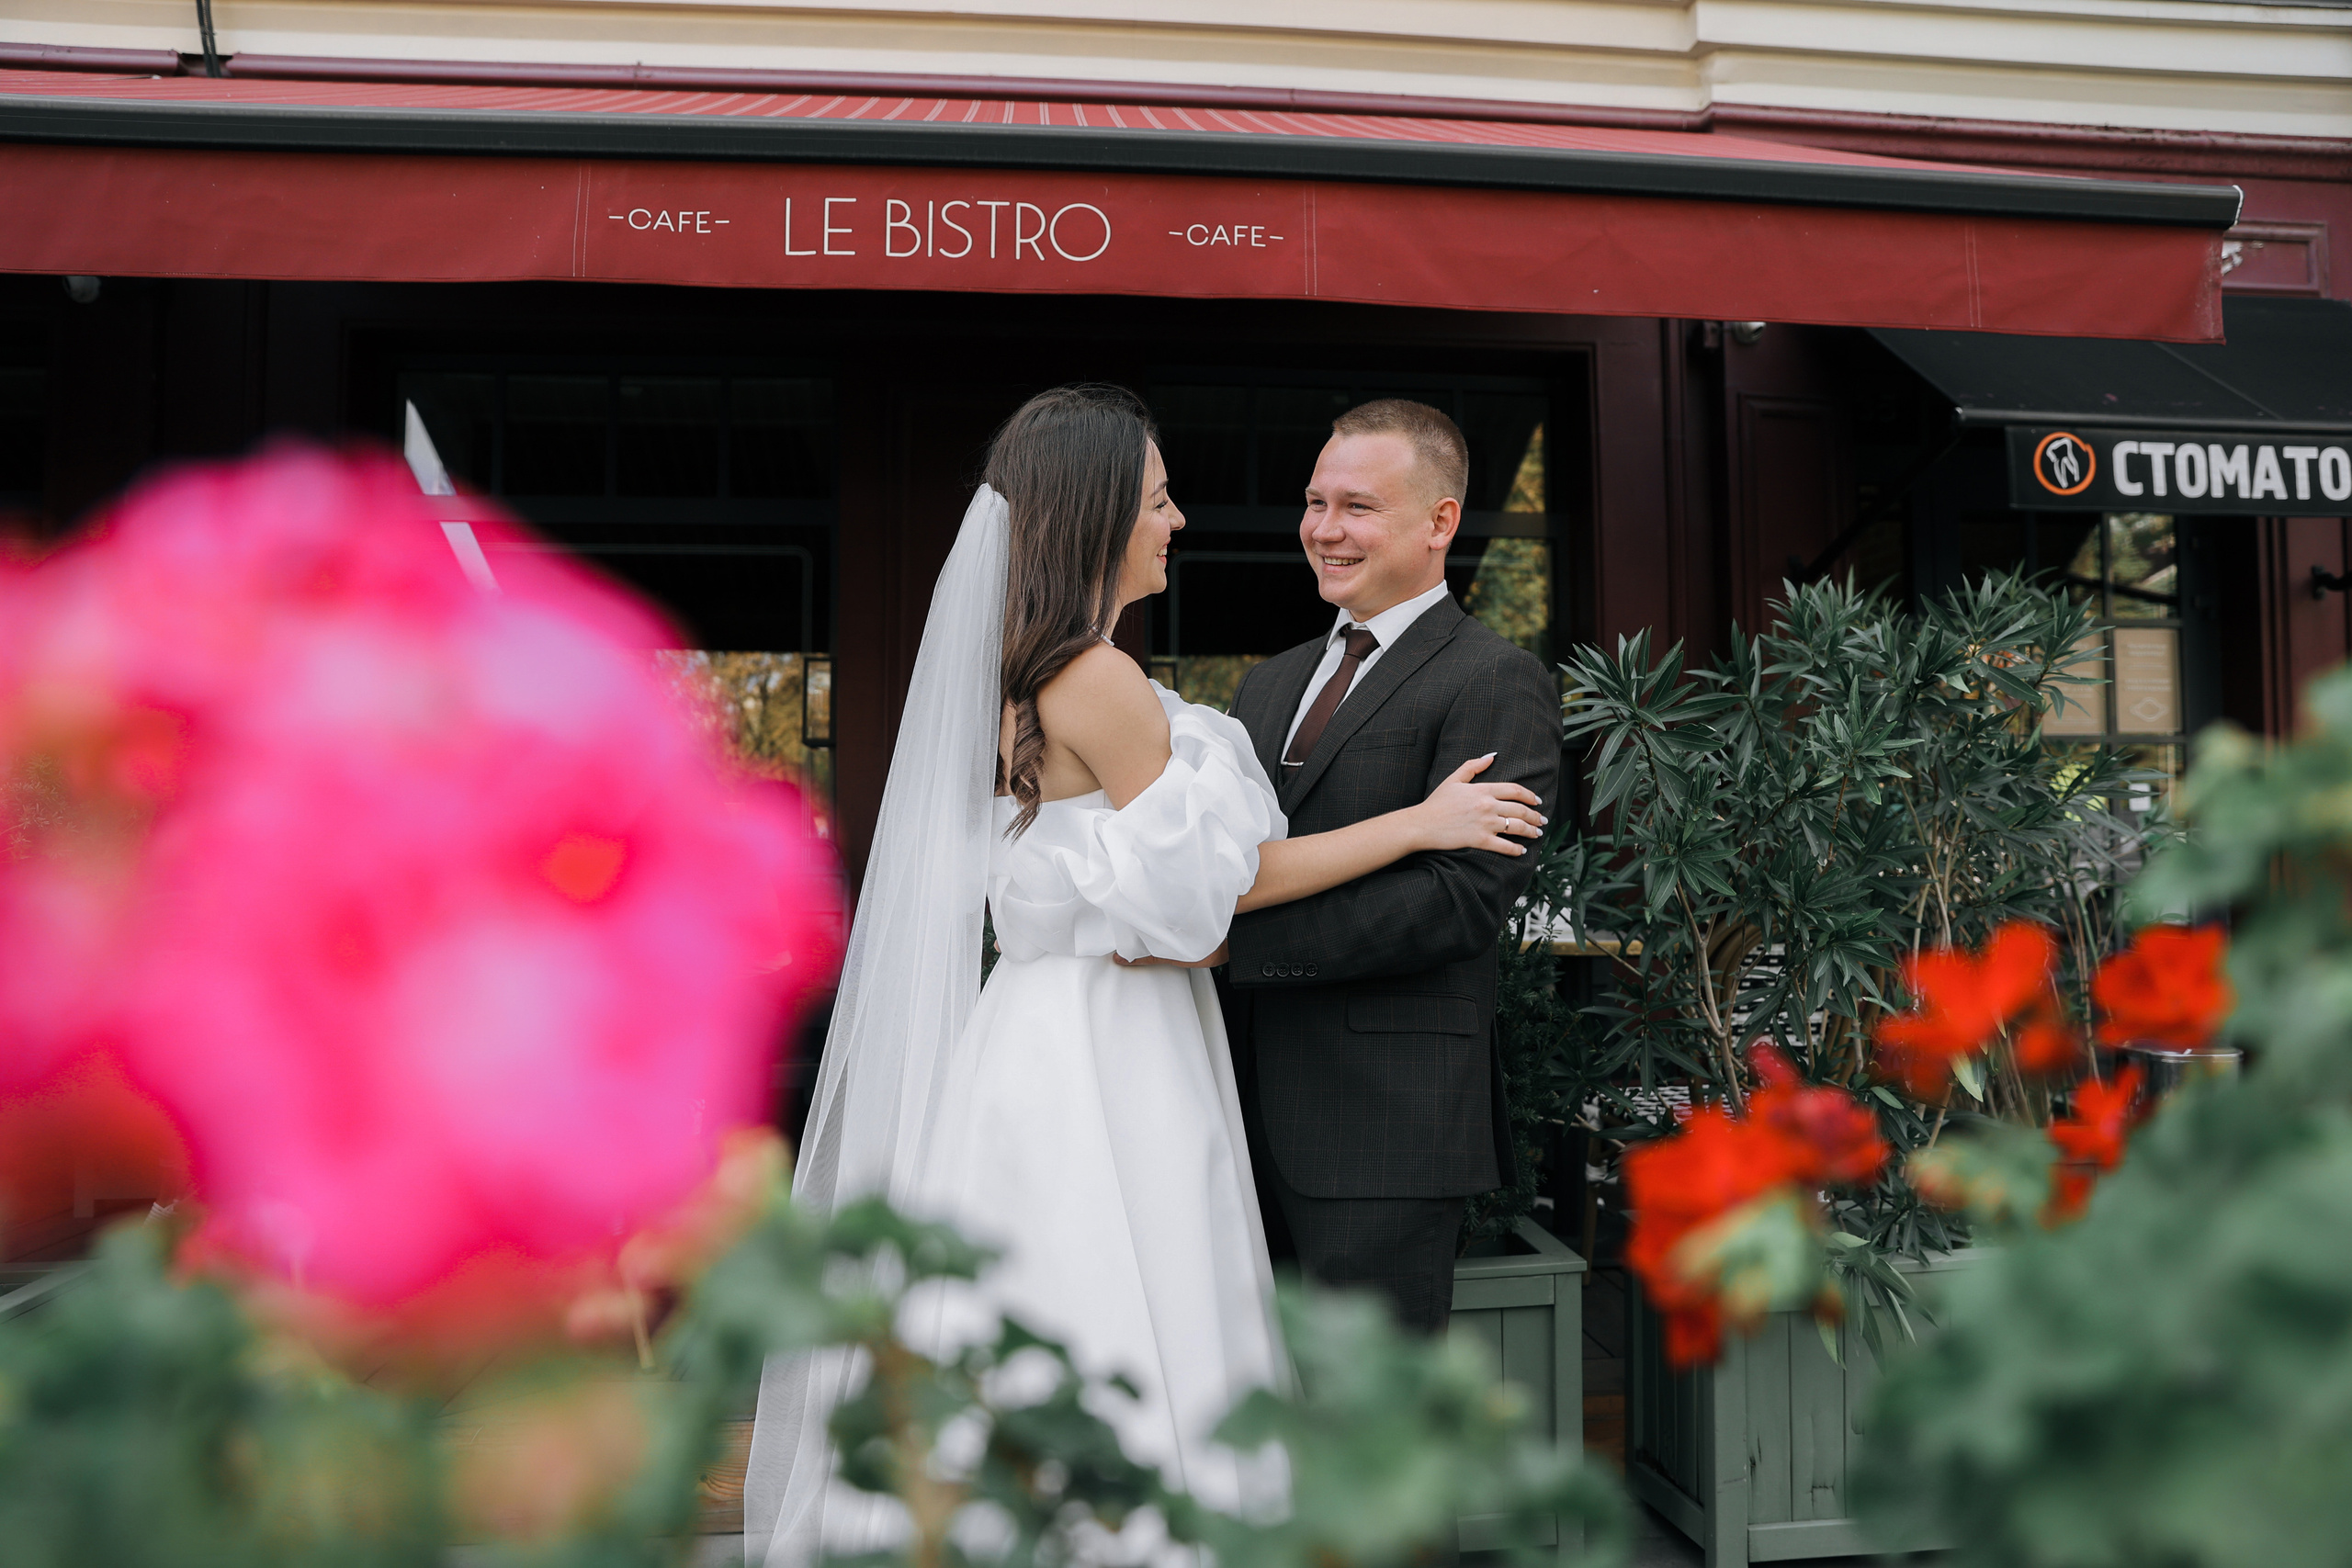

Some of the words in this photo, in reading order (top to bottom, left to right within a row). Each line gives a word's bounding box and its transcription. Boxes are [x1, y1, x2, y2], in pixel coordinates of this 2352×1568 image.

[785, 197, 857, 256] LE
[885, 198, 1112, 262] BISTRO
[2112, 440, 2352, 502] СТОМАТО
